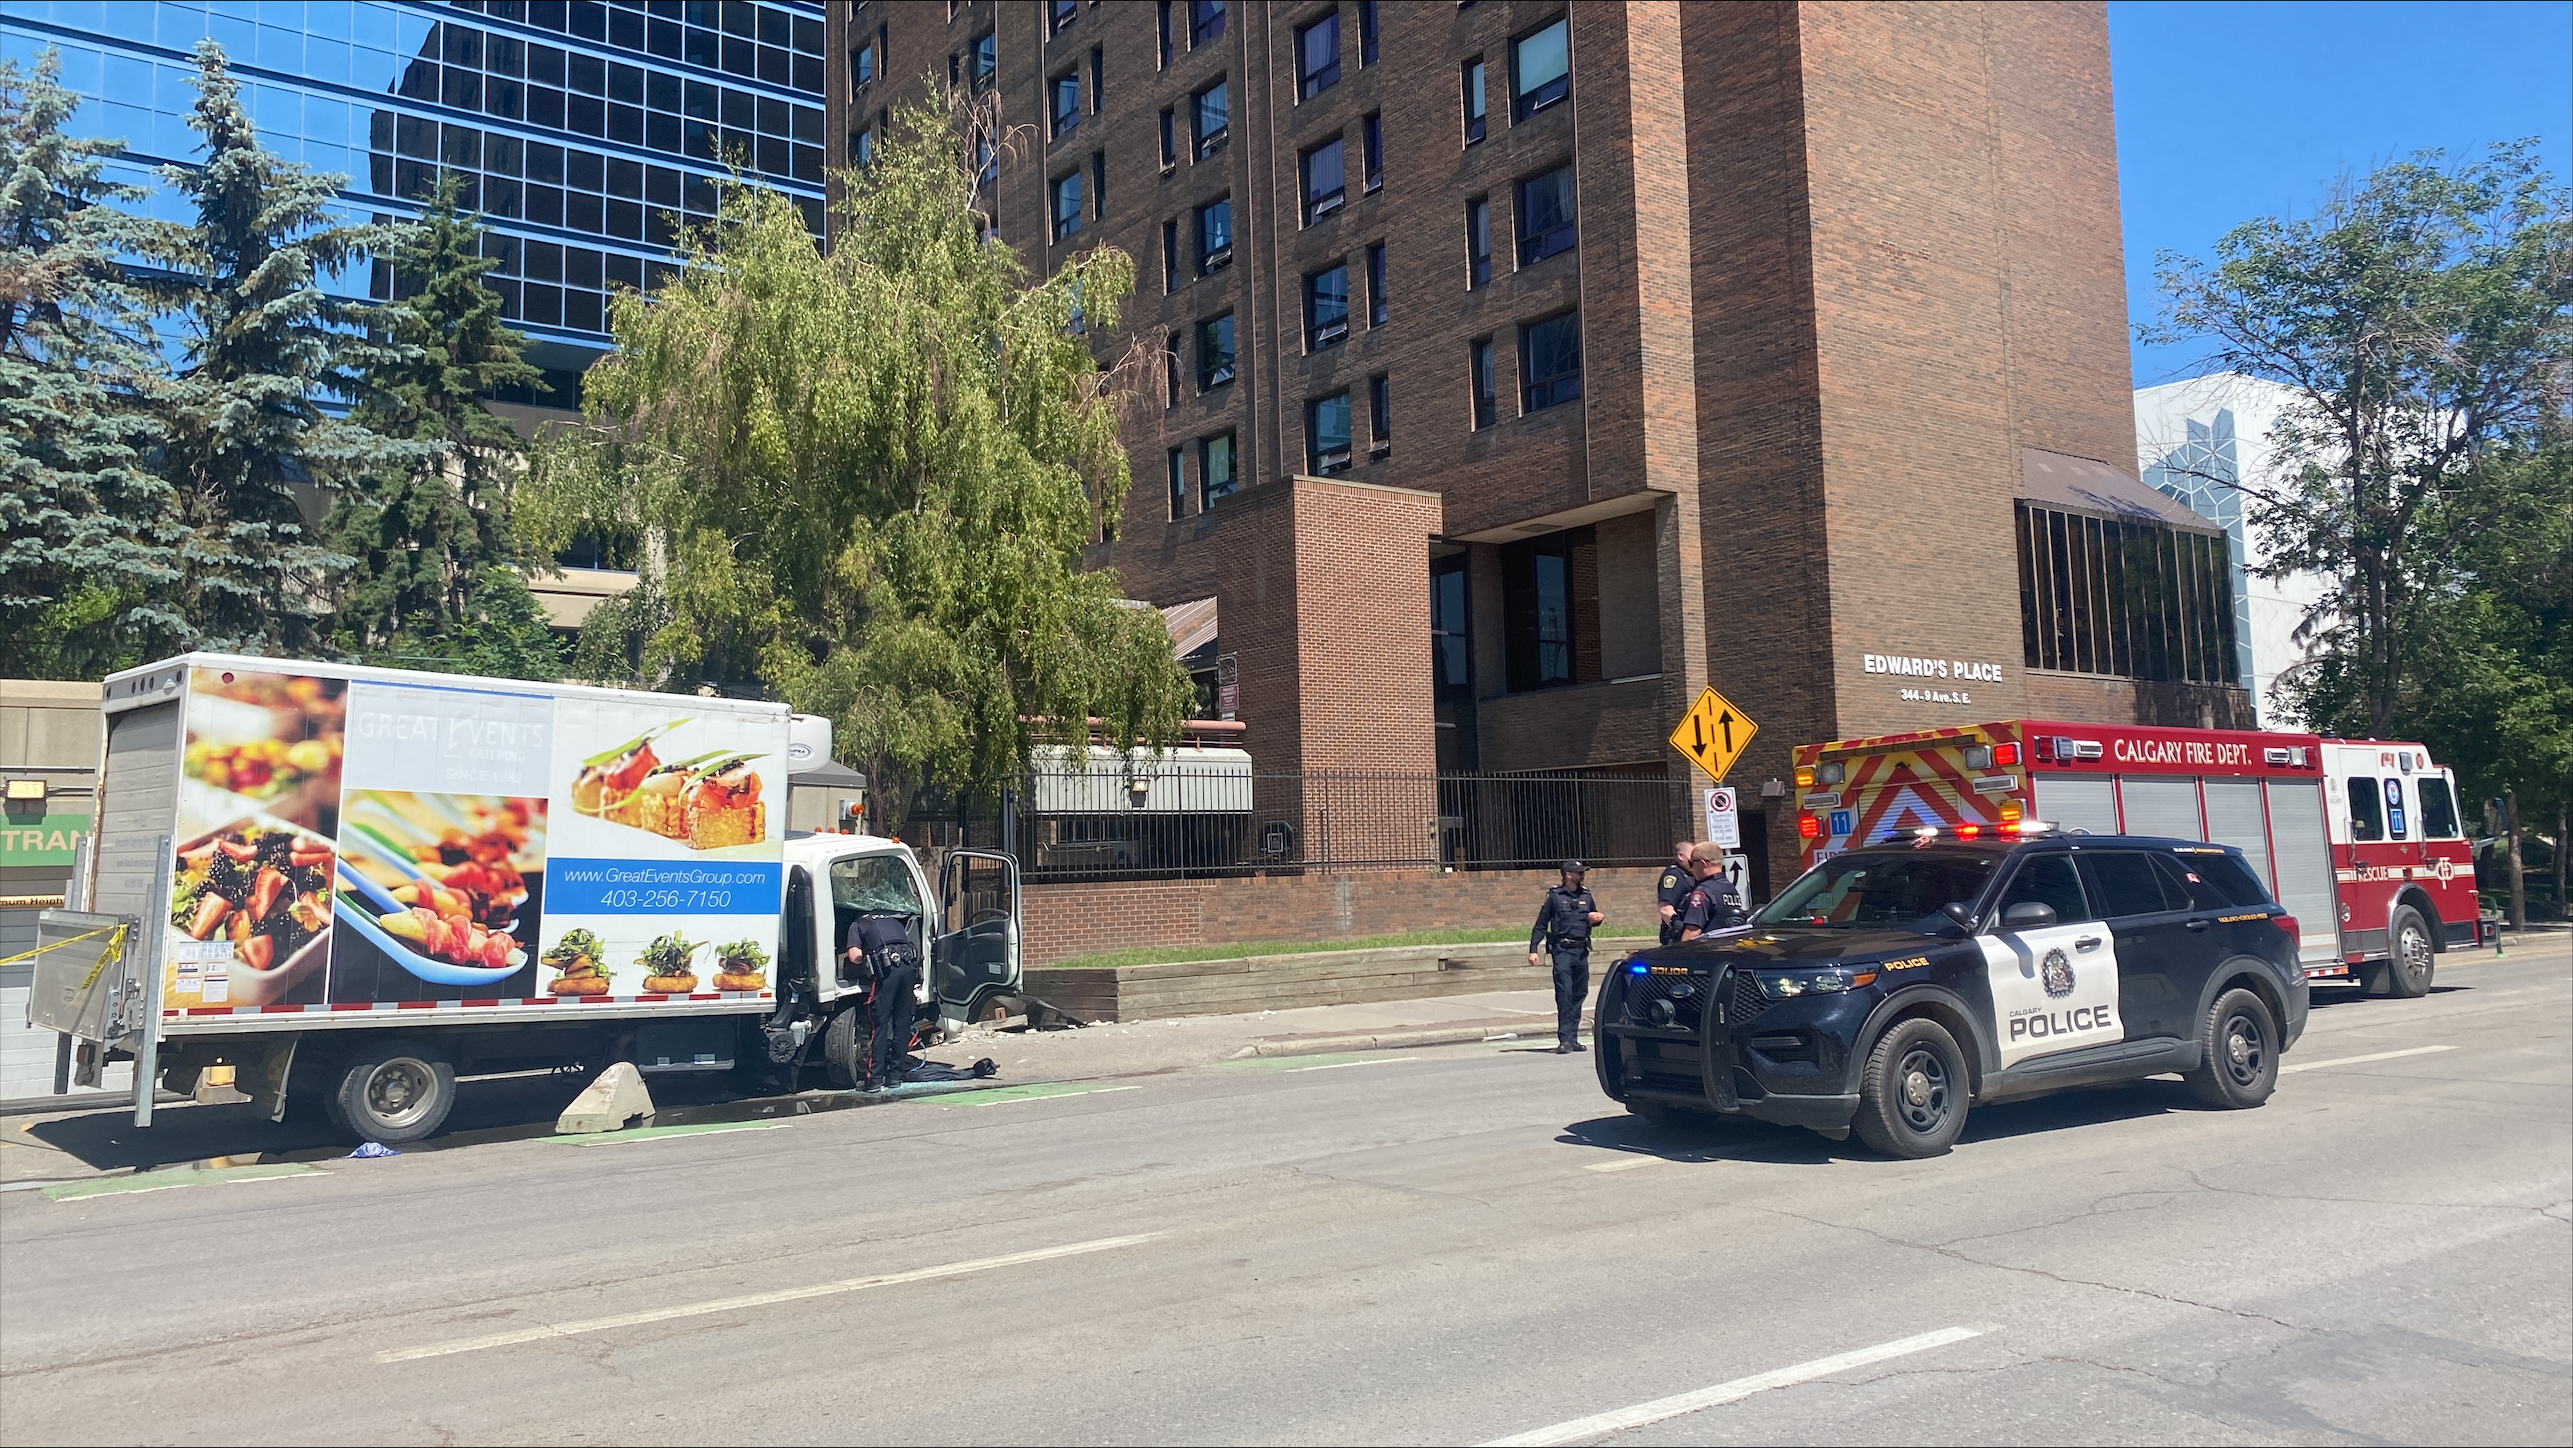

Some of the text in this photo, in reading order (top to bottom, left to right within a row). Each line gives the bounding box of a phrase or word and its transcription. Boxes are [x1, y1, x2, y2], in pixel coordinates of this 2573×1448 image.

[1864, 654, 2003, 682] EDWARD'S PLACE
[358, 712, 441, 742] GREAT
[469, 749, 525, 762] CATERING
[2114, 739, 2253, 766] CALGARY FIRE DEPT.
[445, 768, 523, 784] SINCE 1982
[1834, 814, 1848, 832] 11
[2393, 811, 2403, 830] 11
[564, 867, 766, 887] www.GreatEventsGroup.com
[601, 889, 732, 908] 403-256-7150
[1884, 957, 1930, 971] POLICE
[2009, 1007, 2042, 1018] CALGARY
[2010, 1005, 2112, 1042] POLICE
